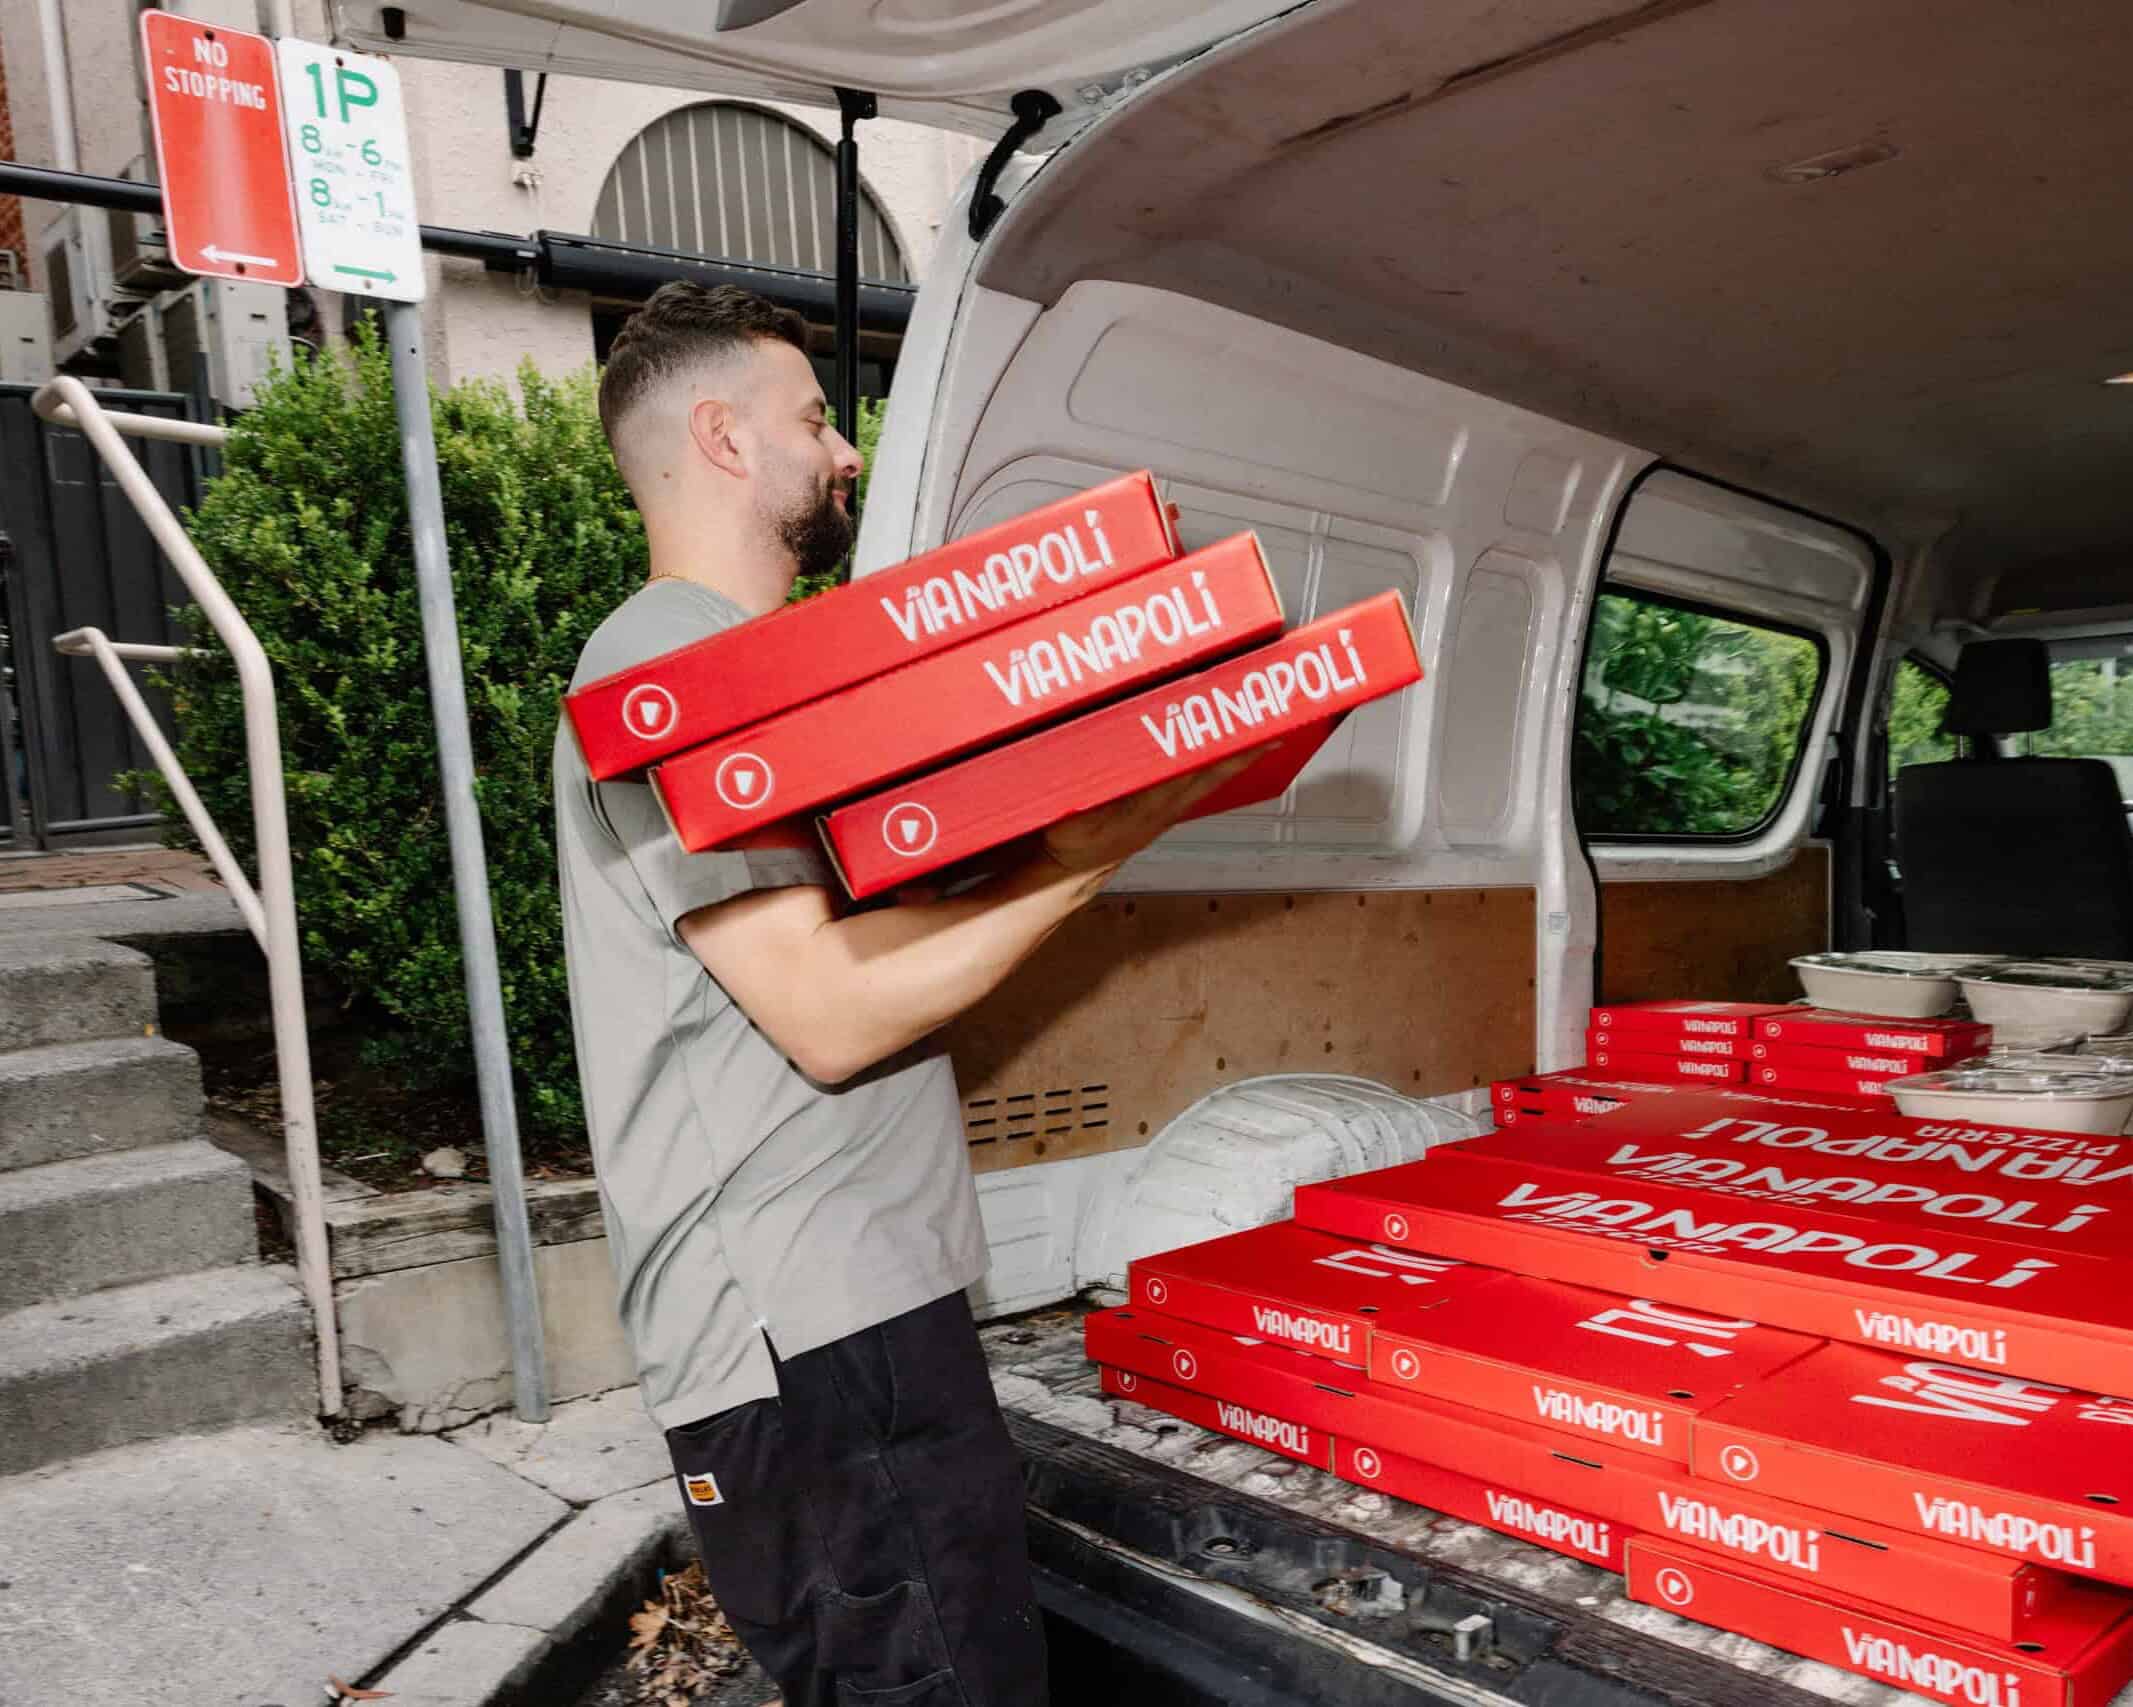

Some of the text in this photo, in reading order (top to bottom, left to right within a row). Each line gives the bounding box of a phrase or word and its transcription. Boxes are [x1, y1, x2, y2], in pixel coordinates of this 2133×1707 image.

[192, 37, 228, 68] NO
[164, 65, 267, 112] STOPPING
[304, 62, 379, 124] 1P
